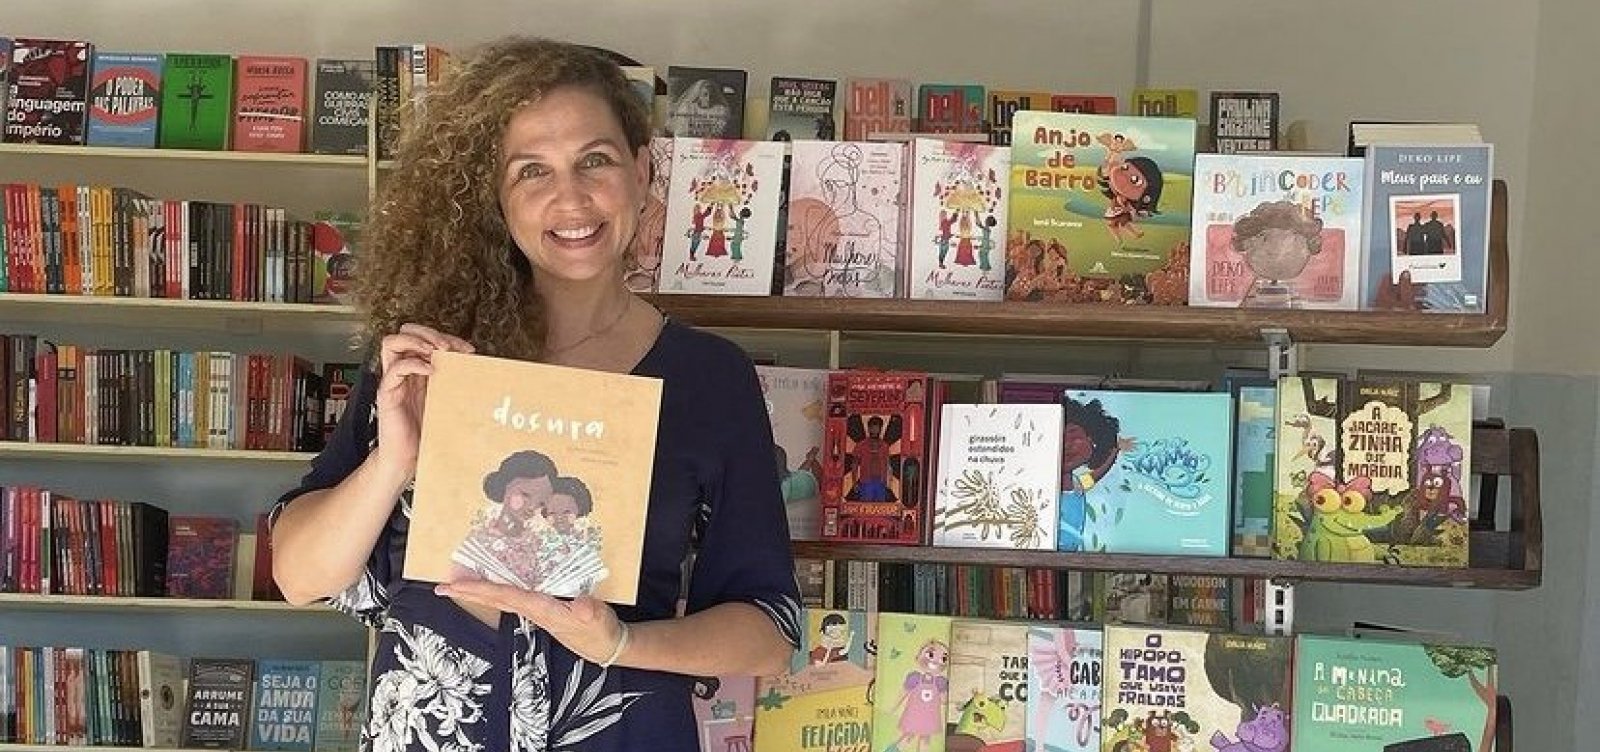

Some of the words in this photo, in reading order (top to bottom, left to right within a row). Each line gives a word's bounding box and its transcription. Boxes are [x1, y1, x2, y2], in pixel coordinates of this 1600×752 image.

[7, 110, 26, 122] do
[6, 121, 63, 139] império
[1033, 126, 1092, 149] Anjo
[1047, 150, 1077, 169] de
[1025, 169, 1099, 192] Barro
[1380, 169, 1415, 184] Meus
[1419, 173, 1448, 191] pais
[1371, 405, 1381, 420] A
[1349, 435, 1403, 455] ZINHA
[1364, 452, 1387, 464] QUE
[1347, 462, 1403, 480] MORDIA
[1145, 633, 1163, 649] O
[1119, 662, 1186, 683] TAMO
[1313, 661, 1325, 681] A
[261, 674, 302, 689] SEJA
[304, 675, 317, 690] O
[1118, 682, 1143, 692] QUE
[193, 690, 244, 702] ARRUME
[260, 689, 315, 708] AMOR
[1118, 691, 1186, 708] FRALDAS
[190, 711, 241, 726] CAMA
[257, 710, 278, 724] DA
[282, 710, 313, 724] SUA
[1311, 701, 1405, 727] QUADRADA
[257, 723, 310, 743] VIDA
